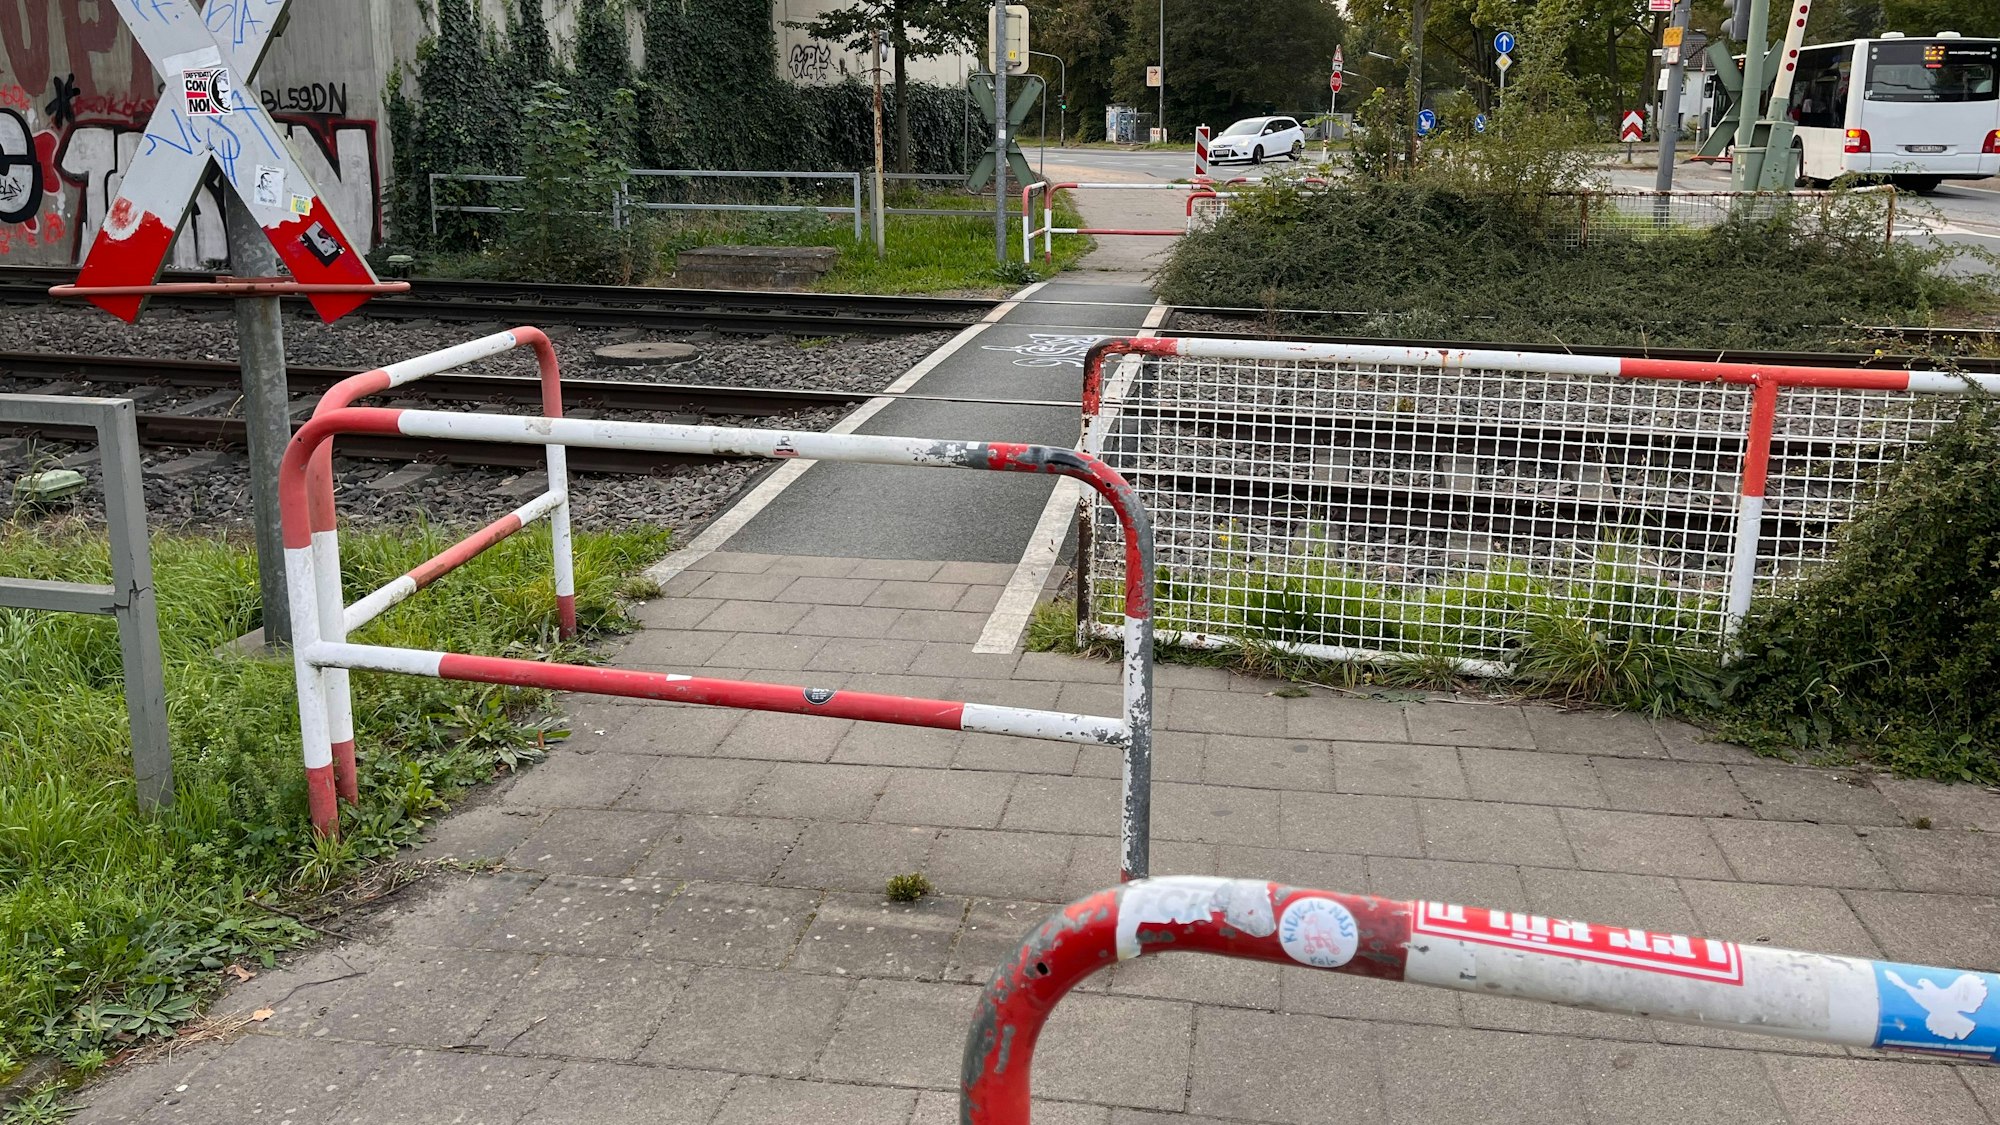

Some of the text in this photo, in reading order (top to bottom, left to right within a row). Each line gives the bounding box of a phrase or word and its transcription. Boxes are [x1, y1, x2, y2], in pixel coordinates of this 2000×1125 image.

[185, 80, 207, 92] CON
[188, 99, 210, 112] NOI
[1328, 906, 1354, 939] MASS
